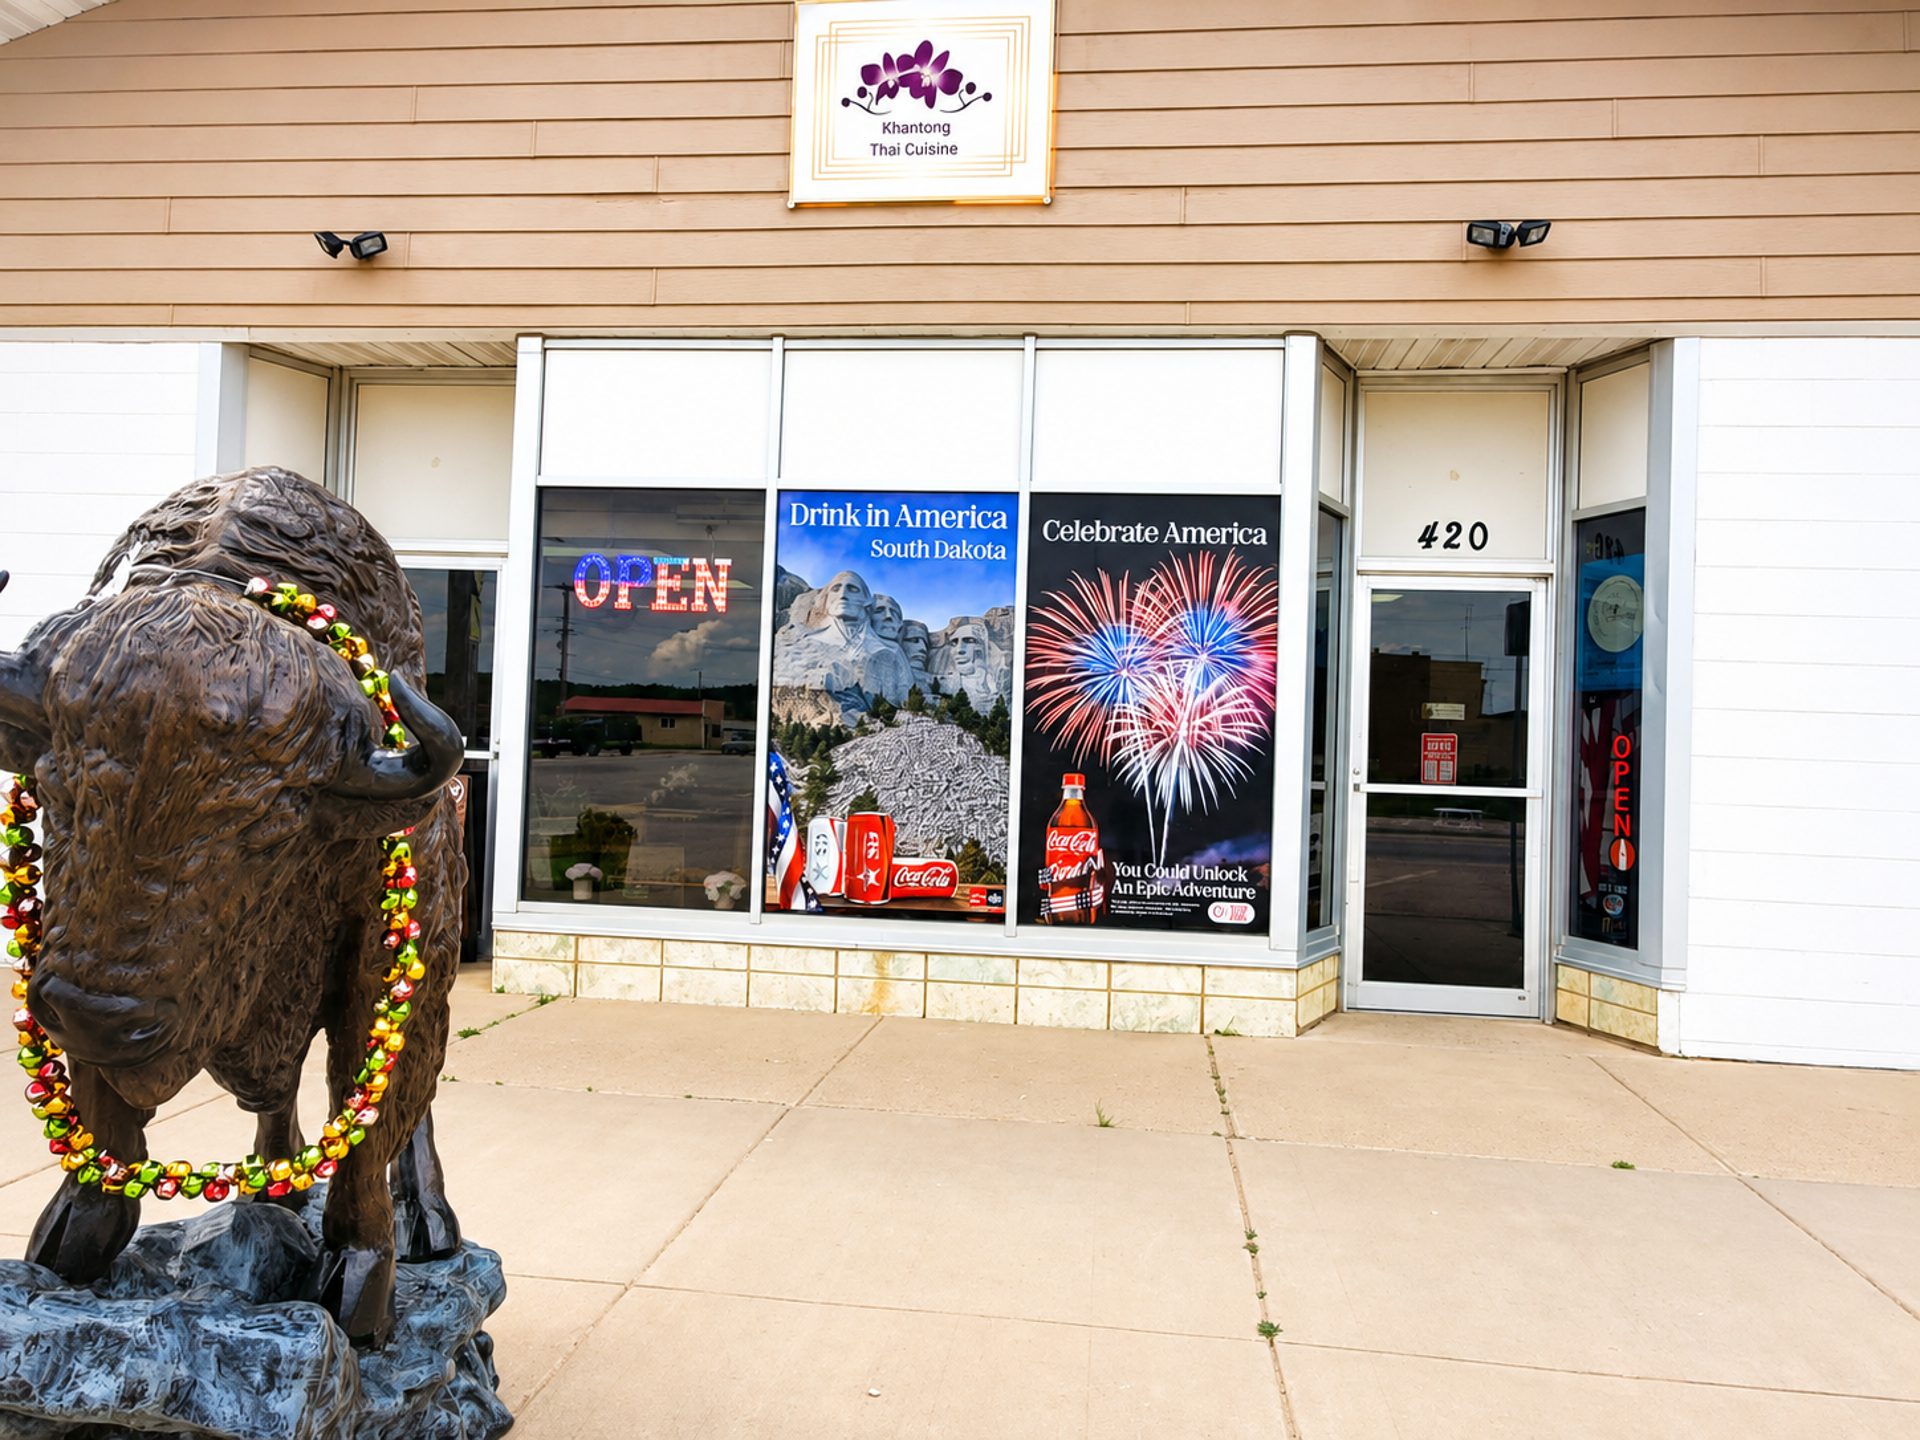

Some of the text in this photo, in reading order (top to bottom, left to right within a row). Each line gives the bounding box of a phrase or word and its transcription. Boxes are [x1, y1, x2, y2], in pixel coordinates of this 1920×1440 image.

[882, 121, 951, 136] Khantong
[870, 142, 958, 156] Thai Cuisine
[790, 502, 1008, 529] Drink in America
[1043, 519, 1268, 546] Celebrate America
[1417, 520, 1489, 551] 420
[871, 539, 1007, 560] South Dakota
[574, 552, 732, 613] OPEN
[1613, 735, 1631, 837] OPEN
[1112, 861, 1249, 882] You Could Unlock
[1111, 879, 1256, 899] An Epic Adventure
